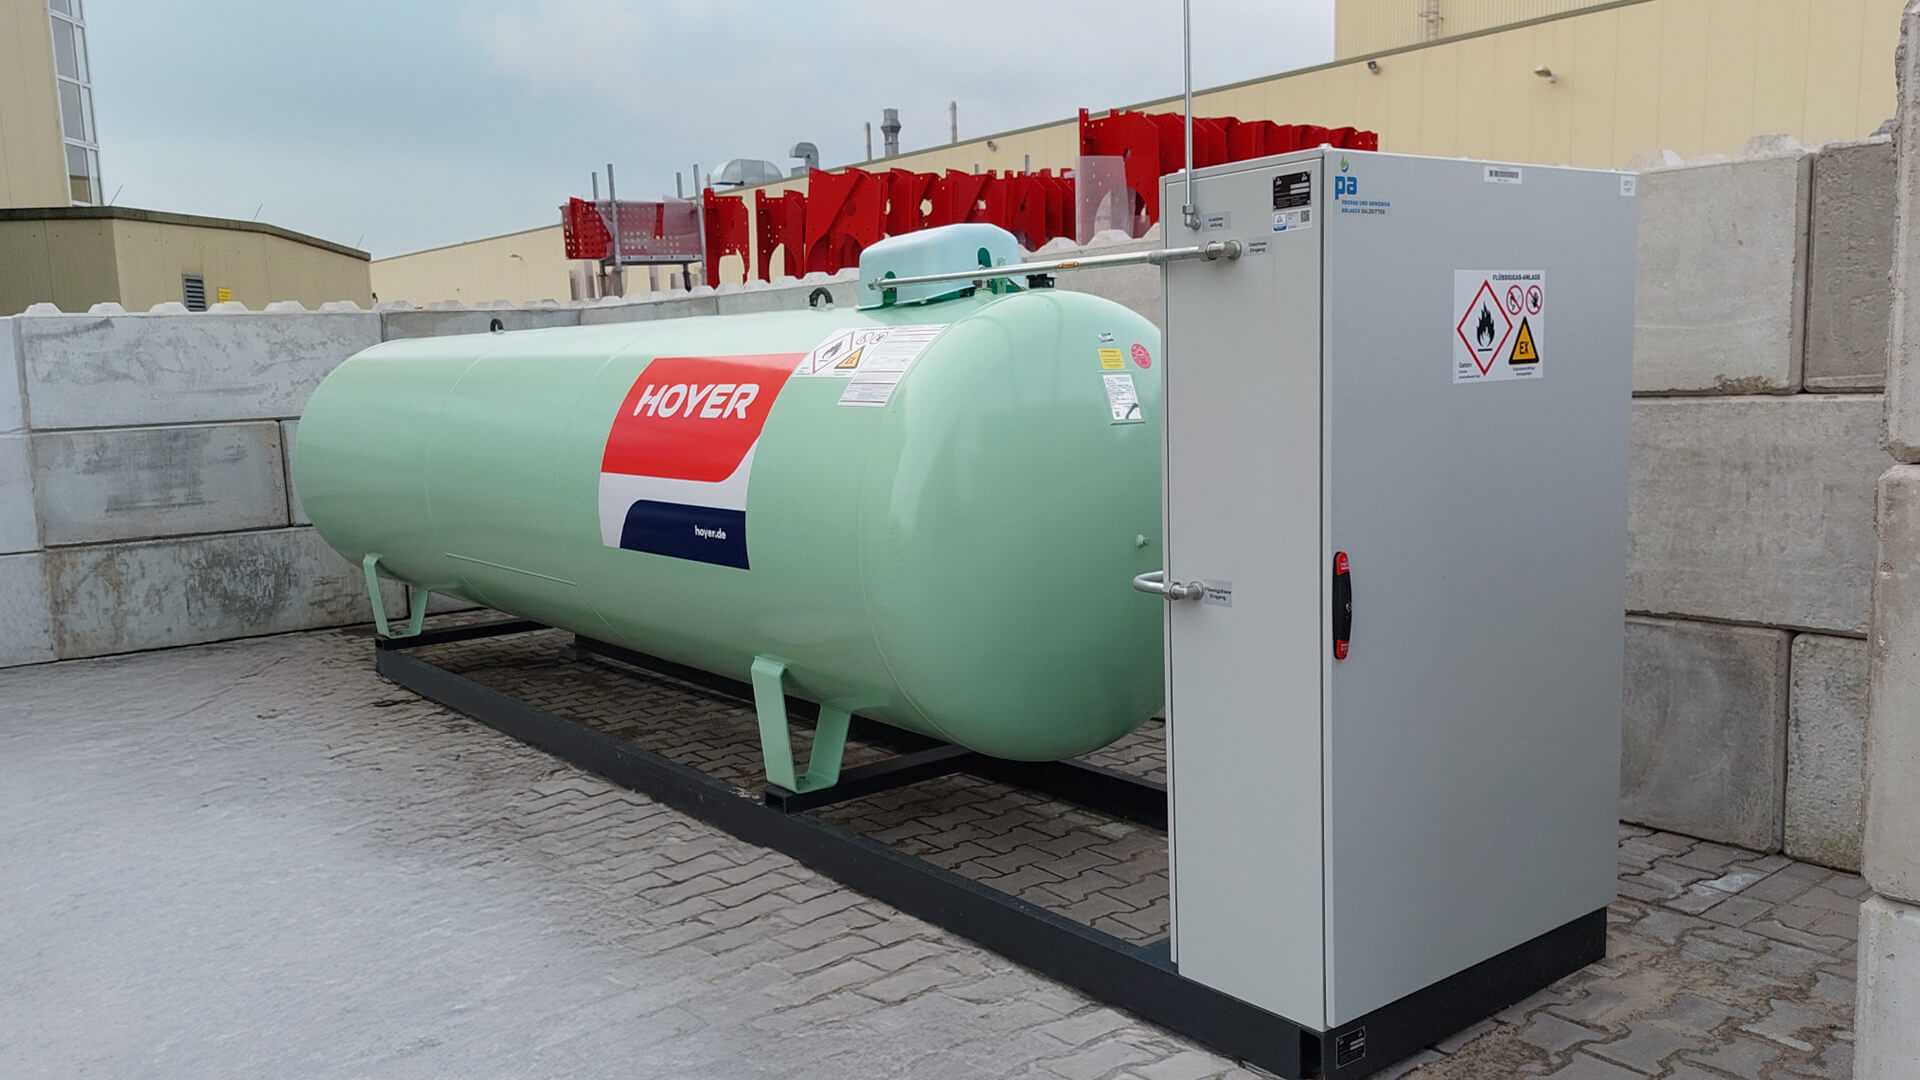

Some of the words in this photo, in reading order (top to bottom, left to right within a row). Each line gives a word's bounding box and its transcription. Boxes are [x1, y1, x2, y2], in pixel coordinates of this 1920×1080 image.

[1335, 176, 1357, 200] pa
[1520, 341, 1529, 354] EX
[633, 384, 760, 419] HOYER
[695, 525, 726, 539] hoyer.de
